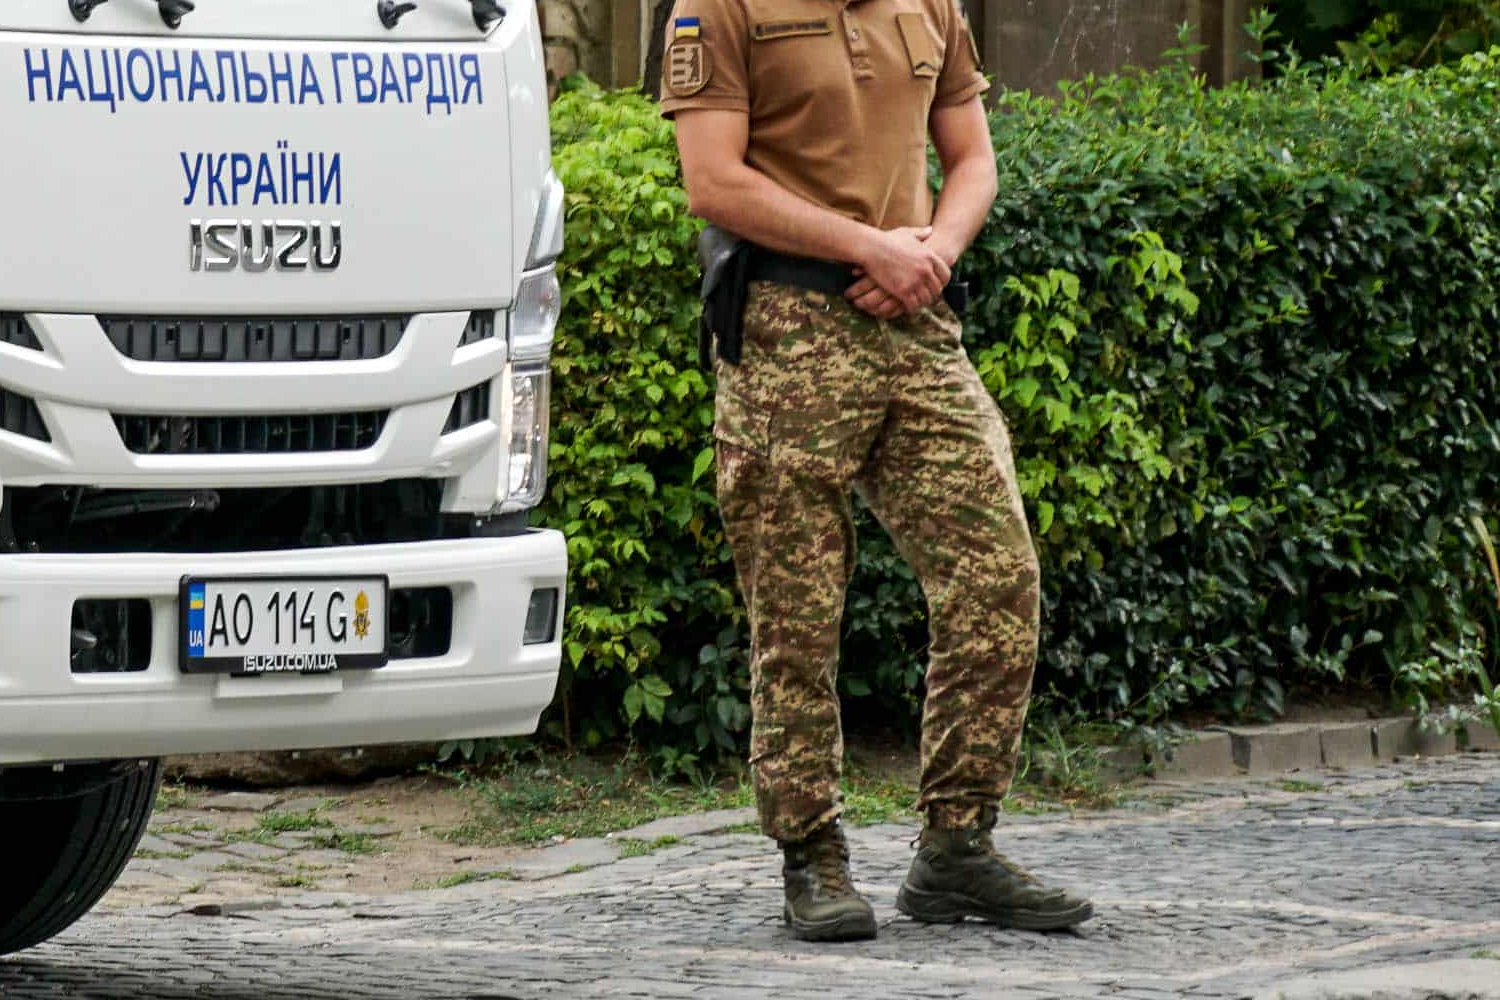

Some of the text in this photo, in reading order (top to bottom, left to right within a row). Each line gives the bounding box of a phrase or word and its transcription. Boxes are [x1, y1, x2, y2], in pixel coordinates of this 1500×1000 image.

[23, 47, 483, 115] НАЦІОНАЛЬНА ГВАРДІЯ
[180, 140, 341, 205] УКРАЇНИ
[190, 217, 342, 272] ISUZU
[189, 630, 203, 647] UA
[209, 590, 347, 646] AO 114 G
[243, 654, 338, 672] ISUZU.COM.UA
